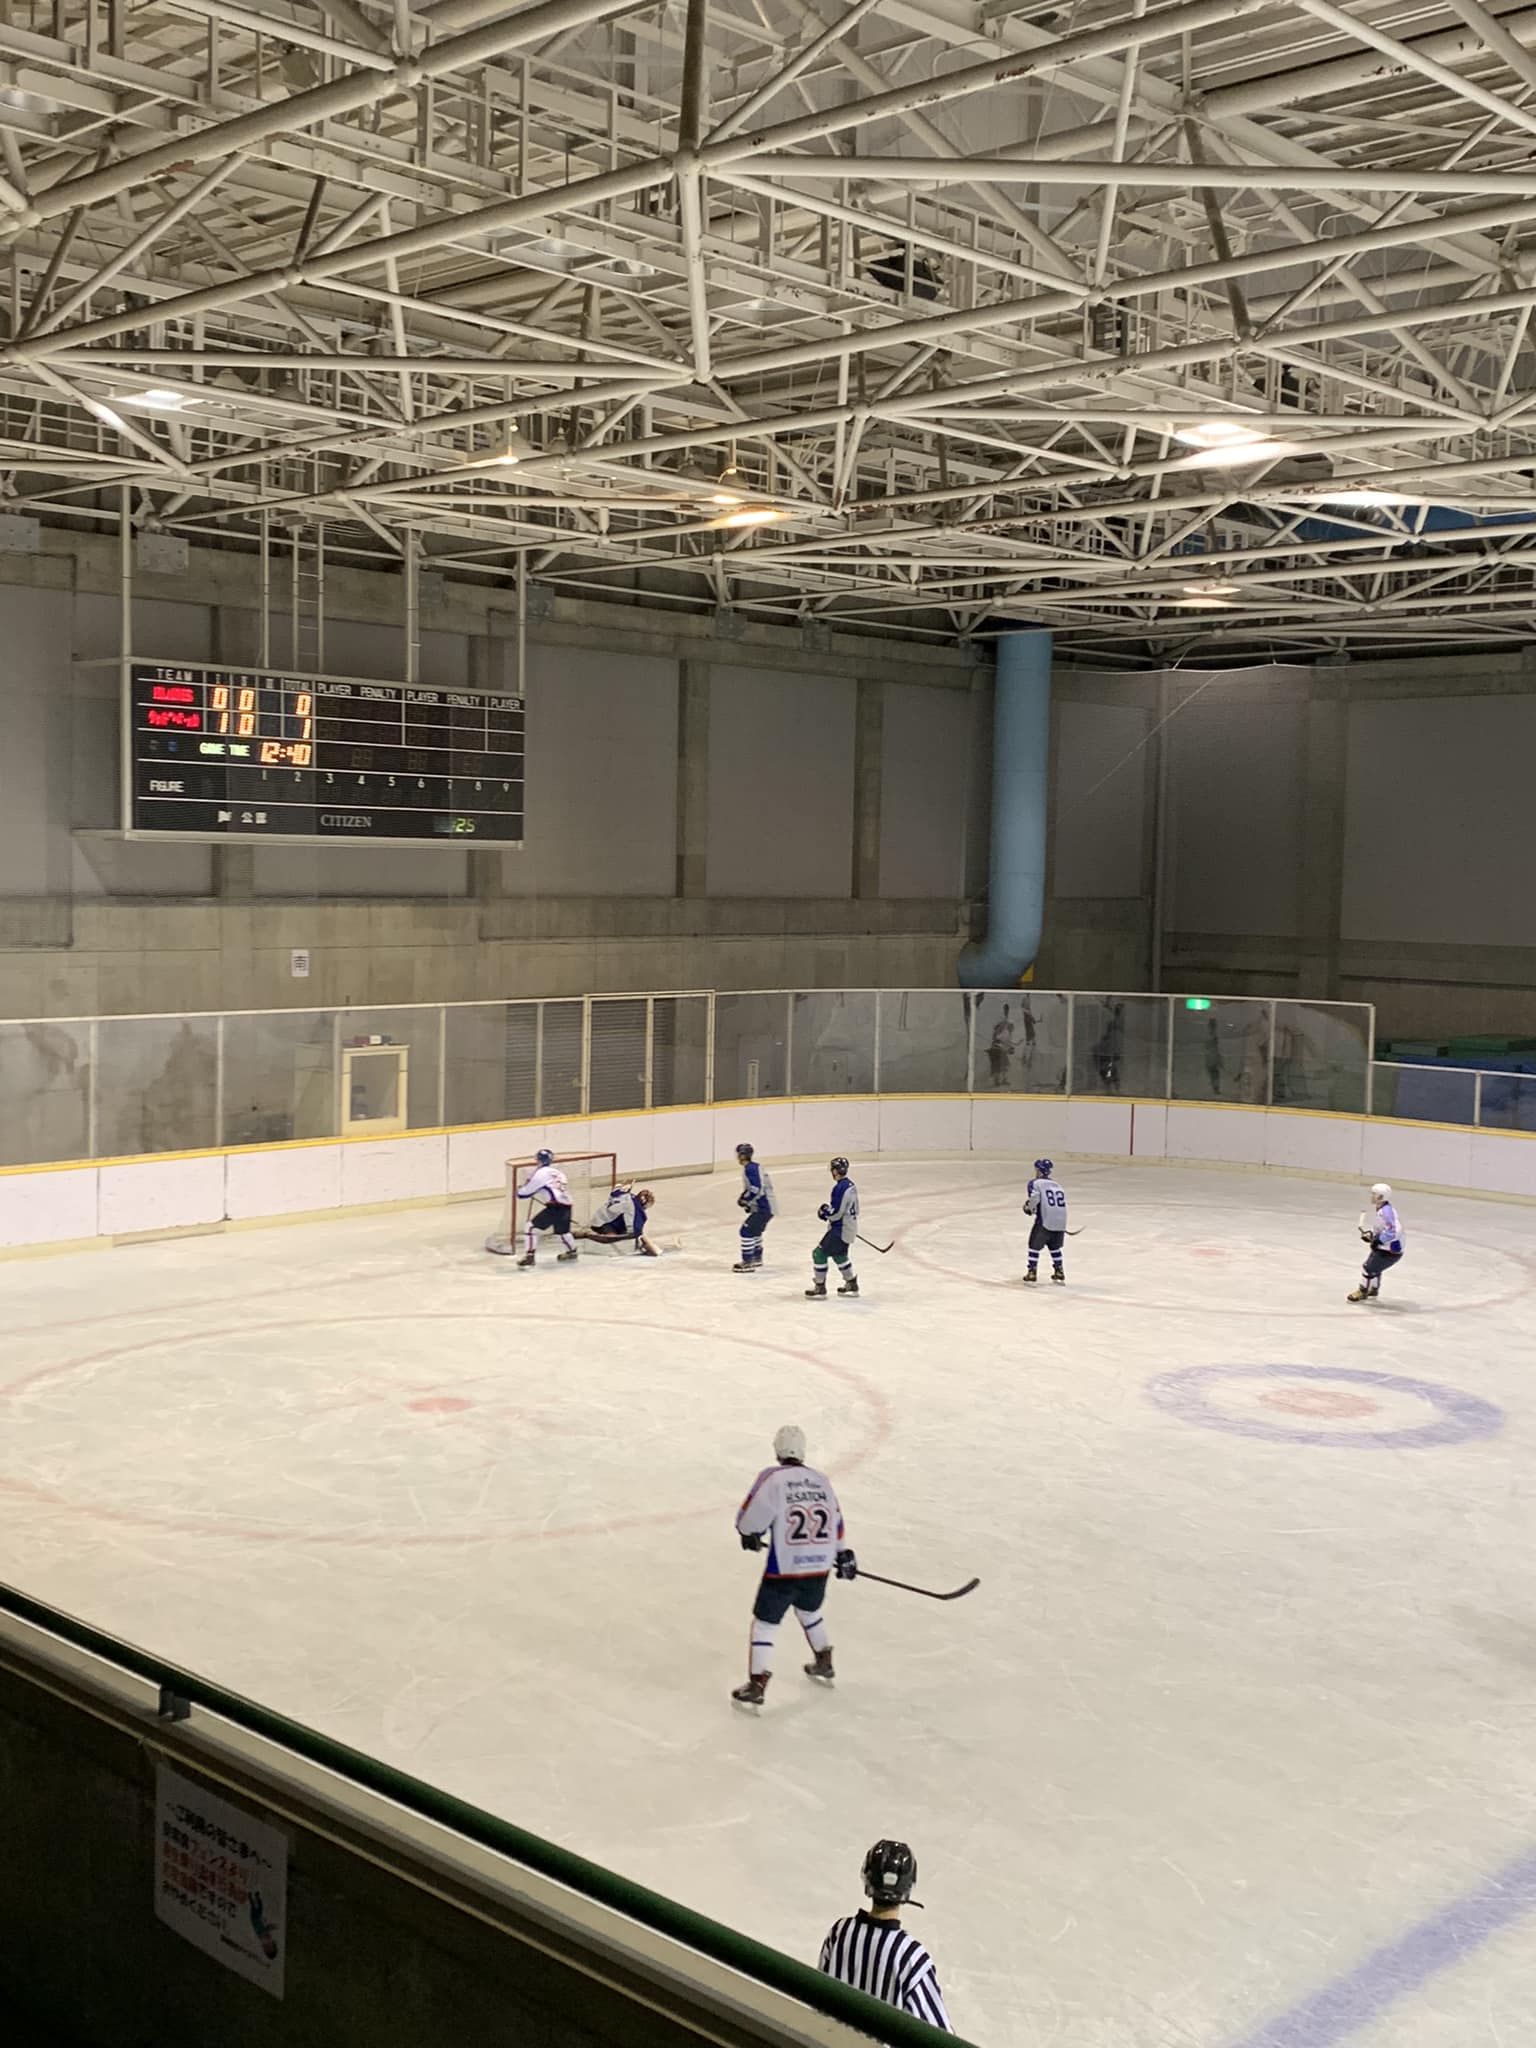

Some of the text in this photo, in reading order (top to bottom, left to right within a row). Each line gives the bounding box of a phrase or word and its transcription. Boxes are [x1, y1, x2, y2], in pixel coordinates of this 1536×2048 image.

[156, 668, 193, 681] TEAM
[284, 680, 312, 692] TOTAL
[318, 683, 397, 699] PLAYER PENALTY
[212, 686, 229, 709] 0
[238, 689, 255, 711] 0
[407, 690, 480, 706] PLAYER PENALTY
[490, 698, 521, 710] PLAYER
[295, 694, 312, 716] 0
[219, 712, 229, 733] 1
[238, 713, 255, 735] 0
[301, 718, 312, 739] 1
[260, 742, 312, 766] 12:40
[294, 771, 302, 782] 2
[325, 773, 334, 784] 3
[358, 775, 365, 785] 4
[388, 776, 396, 787] 5
[417, 778, 425, 788] 6
[447, 779, 454, 790] 7
[474, 780, 482, 791] 8
[502, 782, 510, 792] 9
[320, 814, 372, 827] CITIZEN
[786, 1506, 831, 1544] 22
